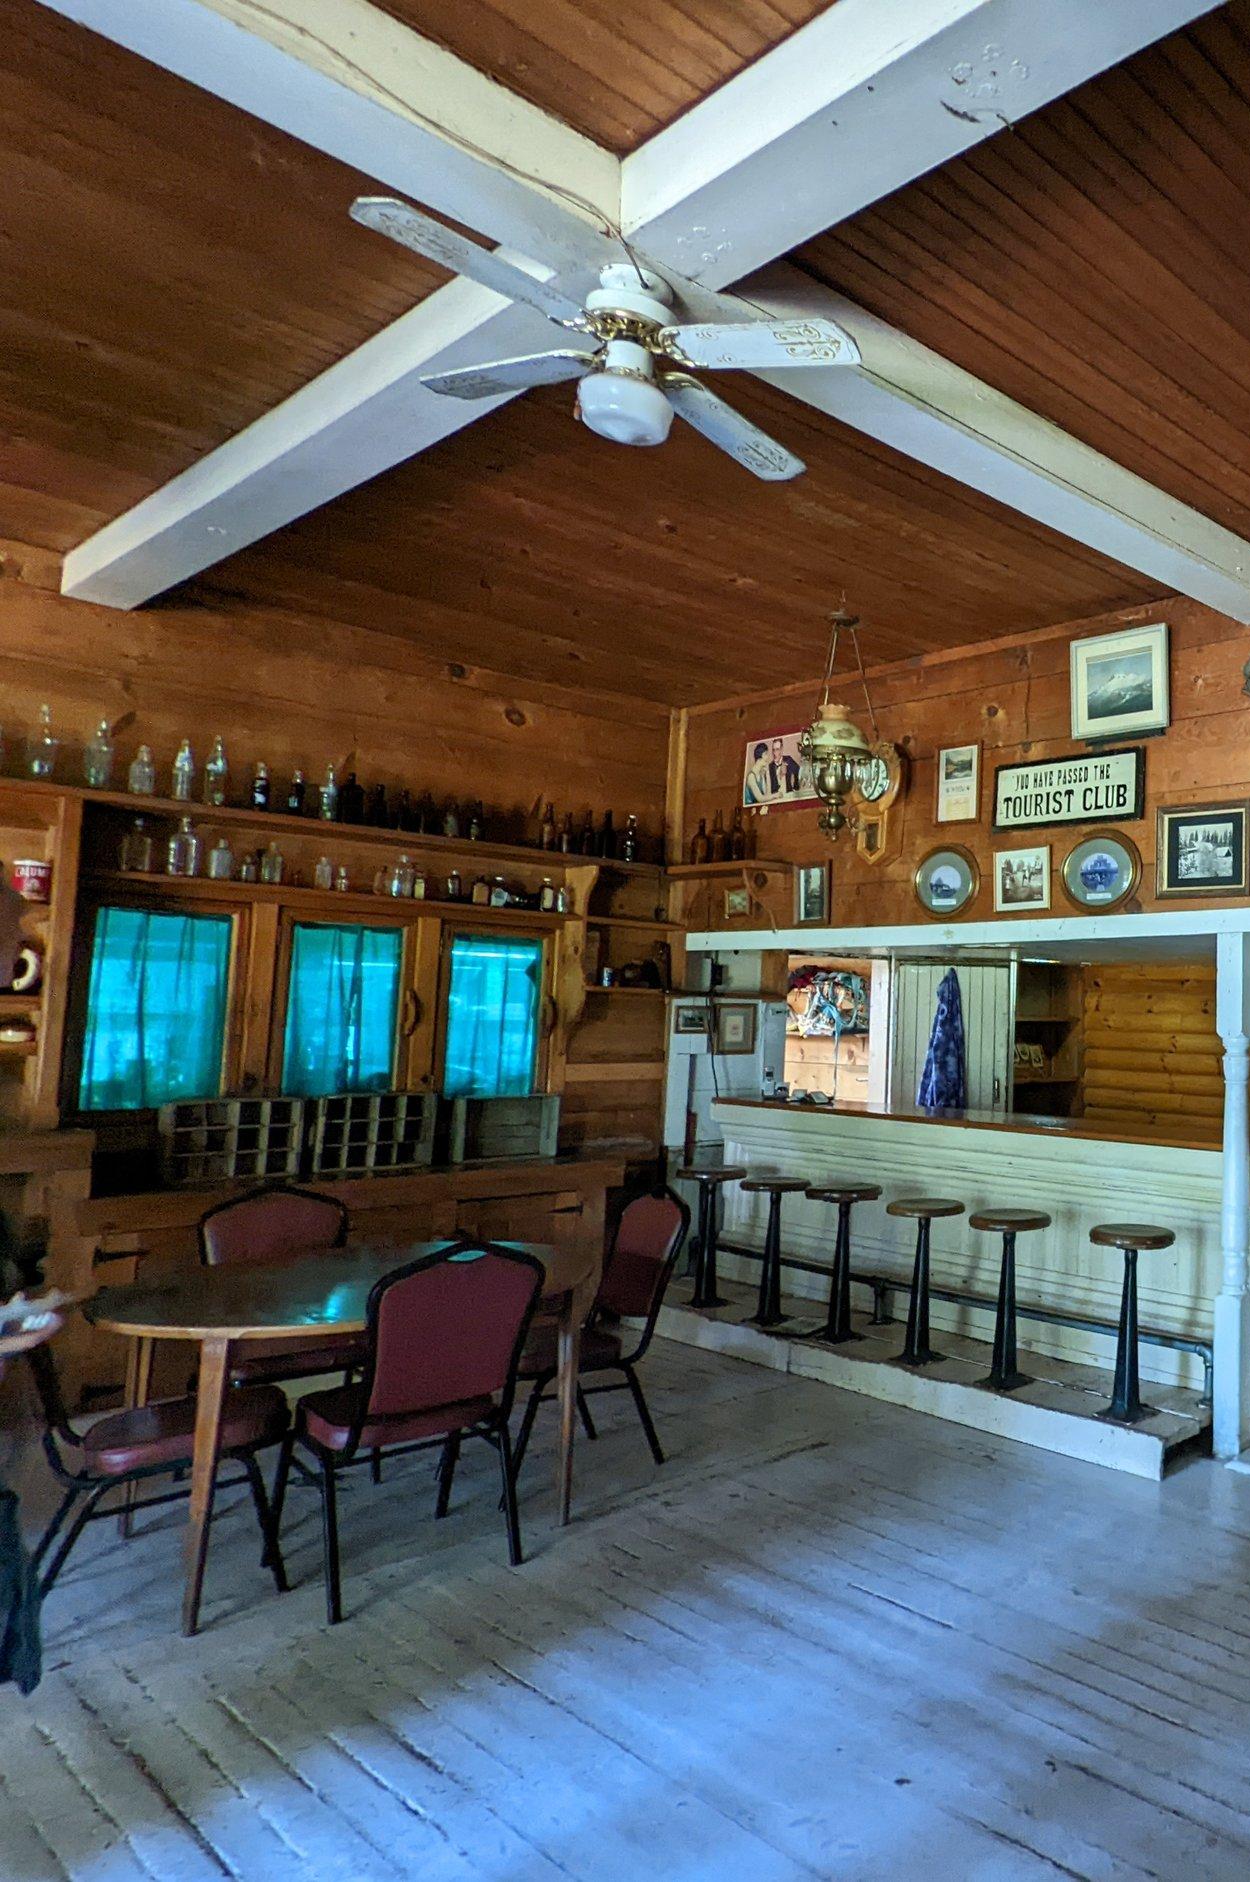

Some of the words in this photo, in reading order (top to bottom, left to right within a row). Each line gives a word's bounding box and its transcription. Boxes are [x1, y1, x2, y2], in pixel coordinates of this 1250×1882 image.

[1033, 771, 1054, 788] HAVE
[1057, 766, 1089, 786] PASSED
[1094, 764, 1111, 781] THE
[1003, 789, 1075, 819] TOURIST
[1082, 784, 1128, 811] CLUB
